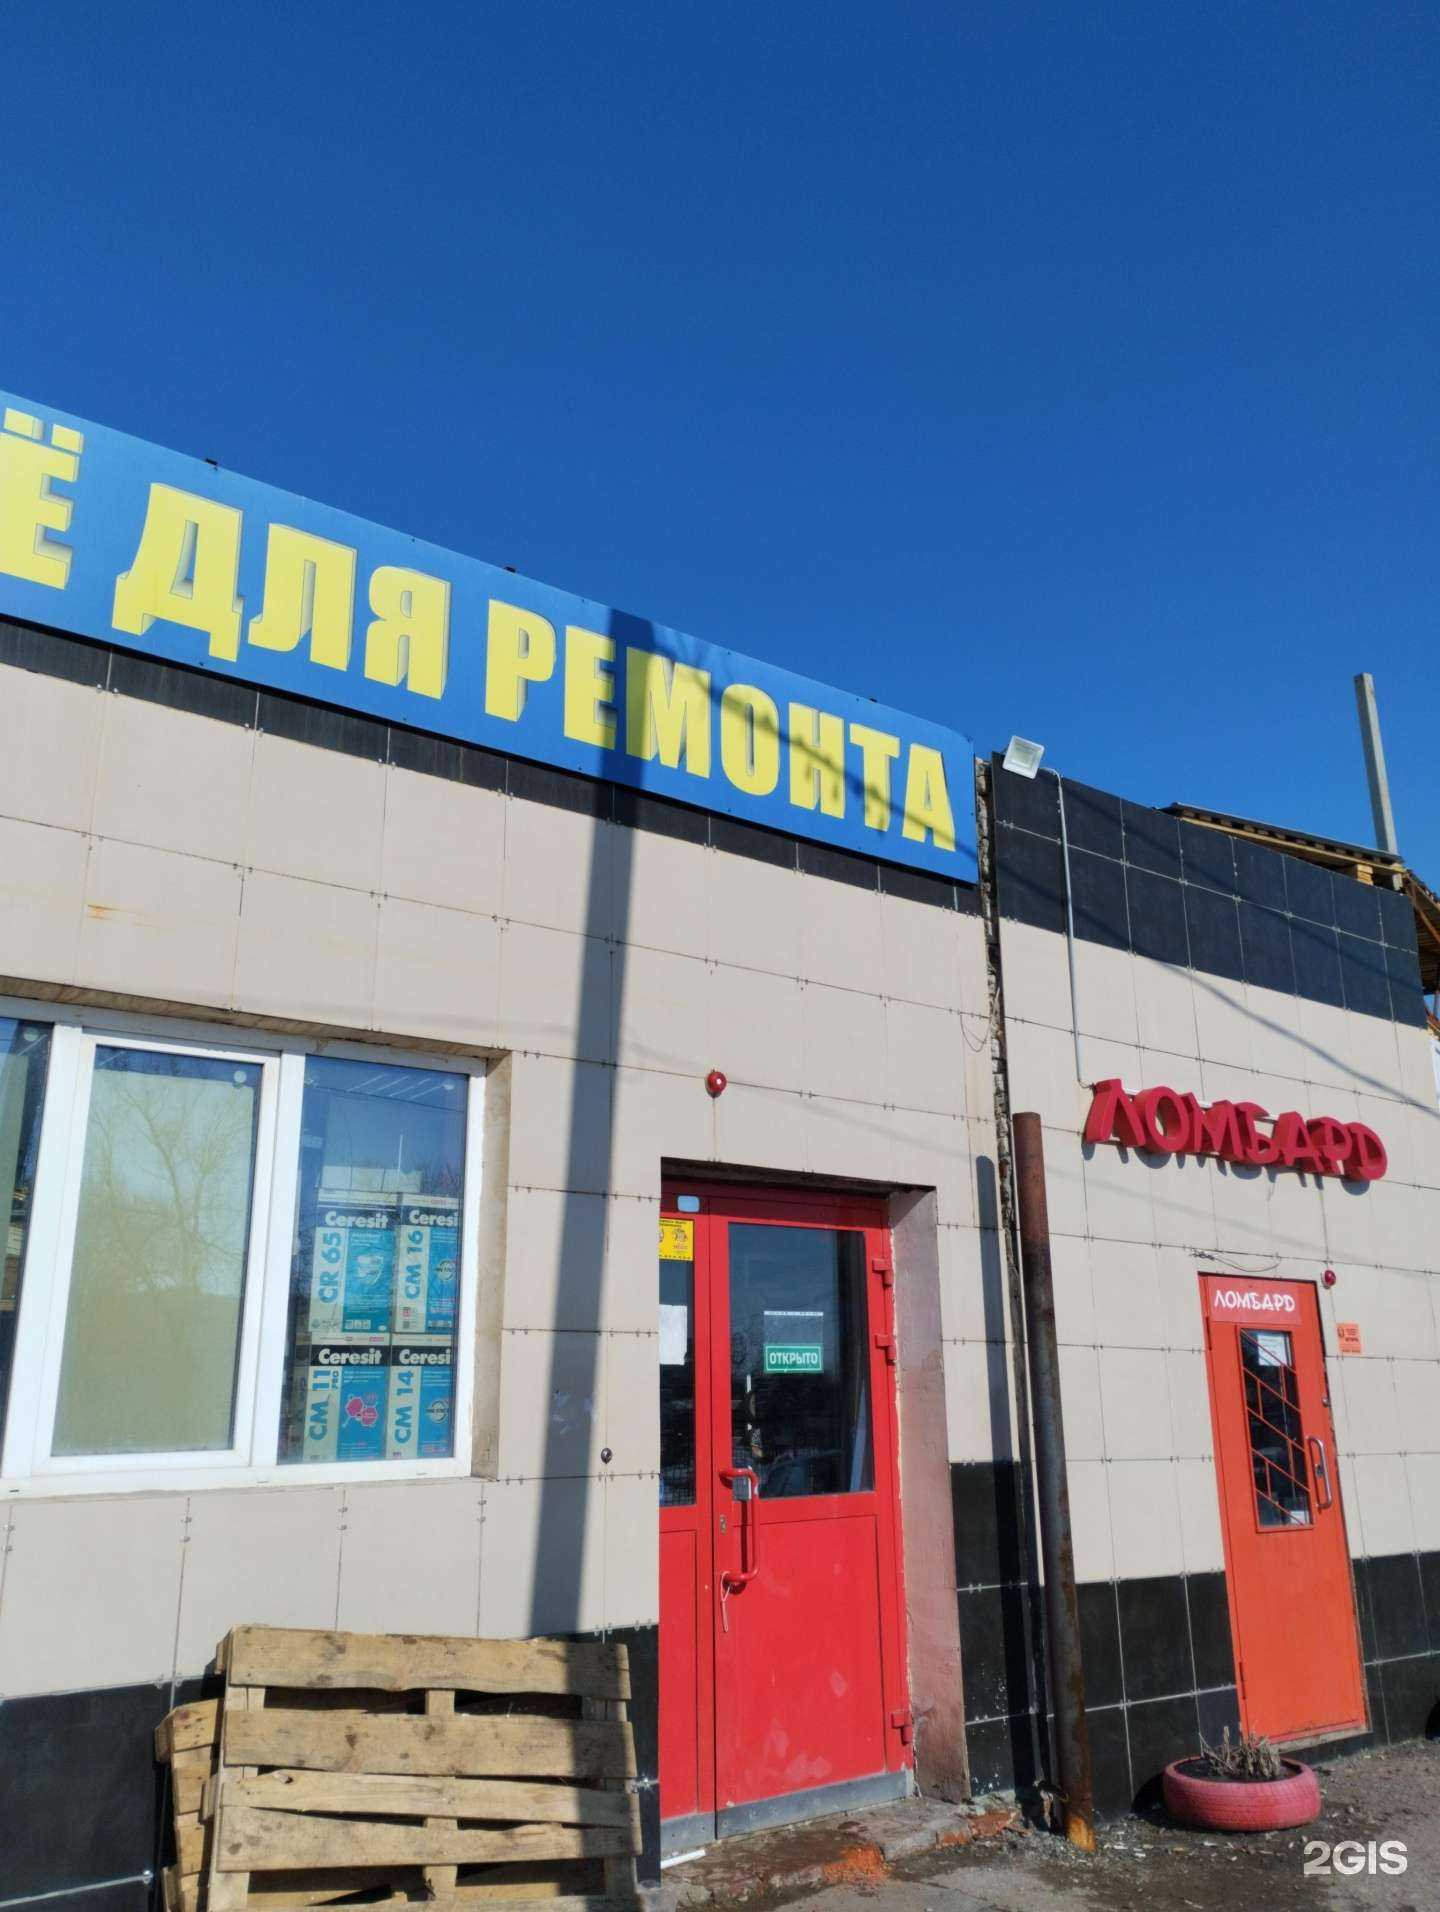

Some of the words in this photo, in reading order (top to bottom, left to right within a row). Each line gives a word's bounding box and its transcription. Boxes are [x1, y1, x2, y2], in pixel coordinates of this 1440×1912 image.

[112, 482, 451, 700] ДЛЯ
[485, 598, 957, 851] РЕМОНТА
[325, 1211, 388, 1228] Ceresit
[322, 1231, 342, 1264] 65
[407, 1230, 423, 1254] 16
[319, 1272, 339, 1303] CR
[405, 1264, 421, 1299] CM
[318, 1347, 382, 1365] Ceresit
[769, 1351, 818, 1365] ОТКРЫТО
[312, 1370, 330, 1391] 11
[397, 1371, 413, 1396] 14
[309, 1401, 328, 1440] CM
[395, 1406, 412, 1443] CM
